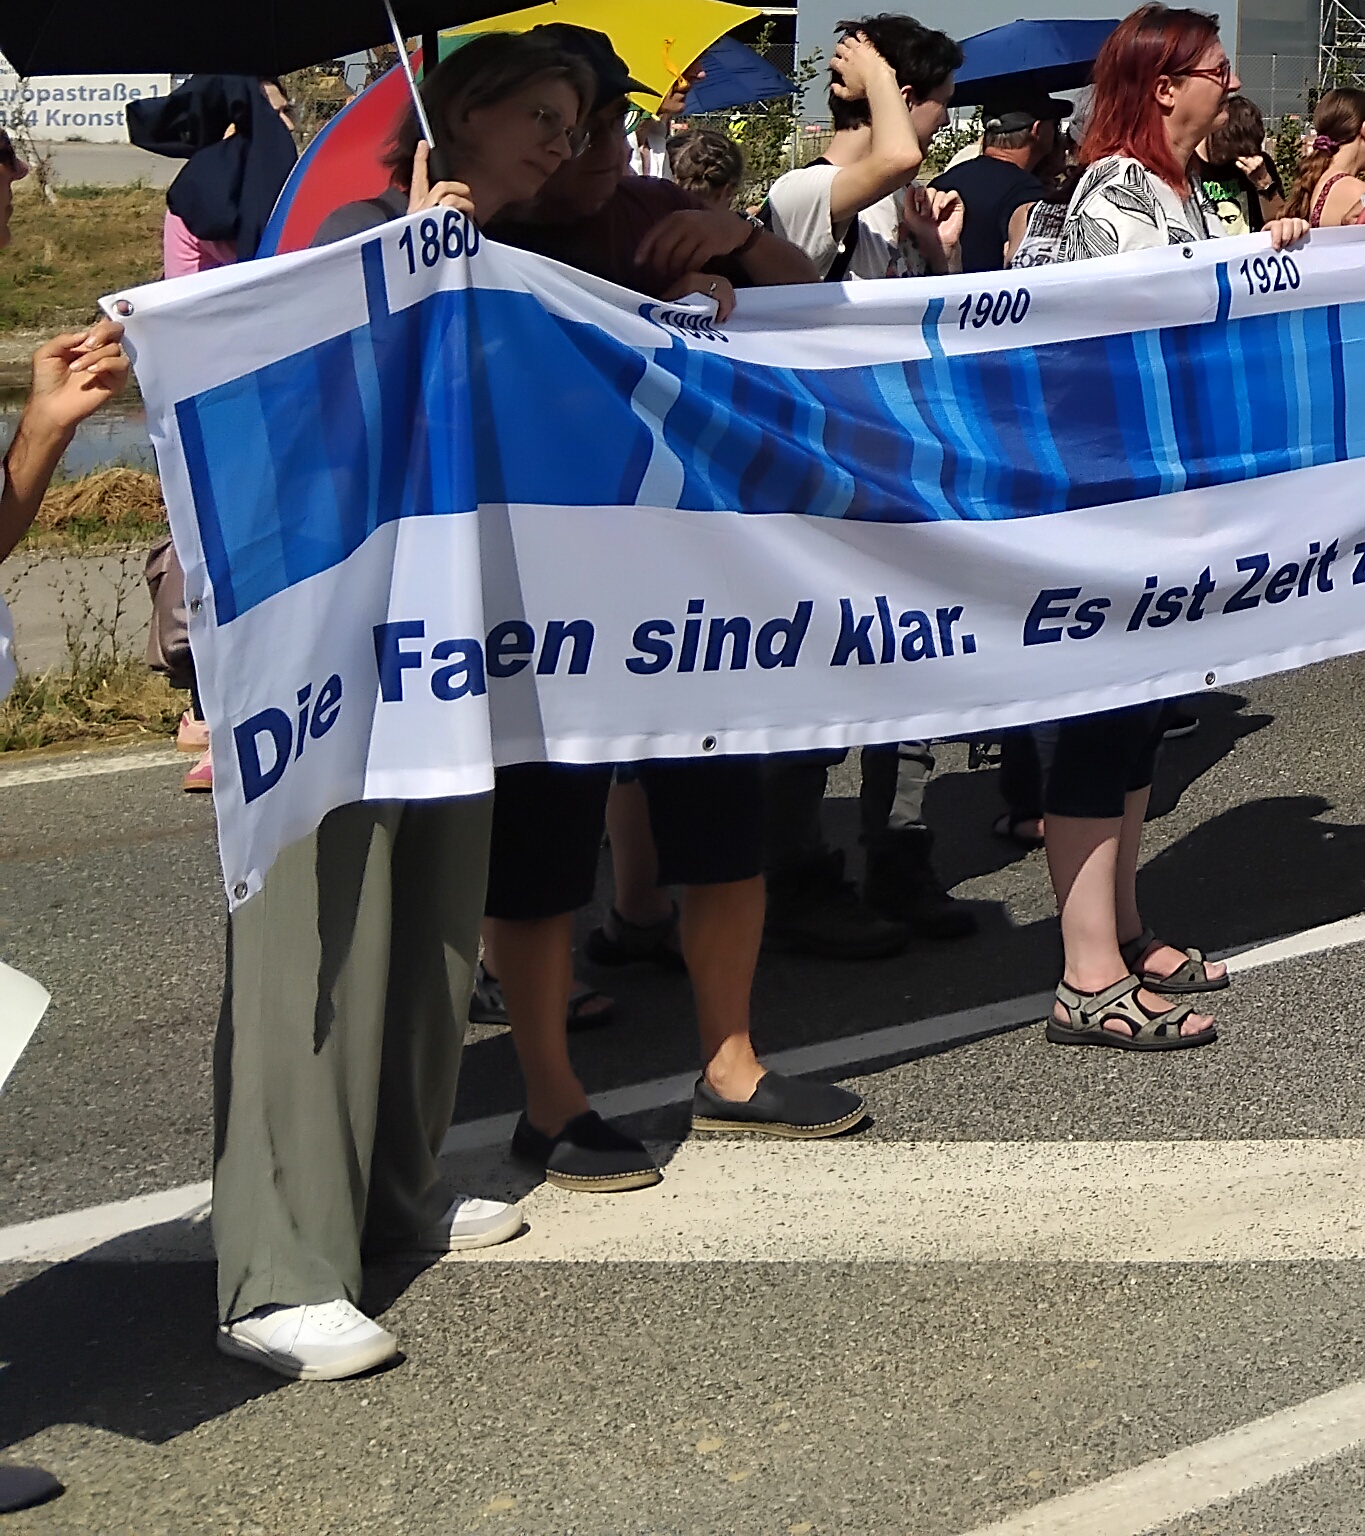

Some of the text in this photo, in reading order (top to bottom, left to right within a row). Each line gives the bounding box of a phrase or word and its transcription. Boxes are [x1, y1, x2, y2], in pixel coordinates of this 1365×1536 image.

[399, 210, 480, 275] 1860
[957, 287, 1030, 330] 1900
[1240, 255, 1301, 297] 1920
[233, 674, 343, 804] Die
[624, 599, 814, 674] sind
[829, 596, 977, 667] klar.
[1023, 586, 1111, 646] Es
[1126, 566, 1215, 632] ist
[1222, 536, 1340, 614] Zeit
